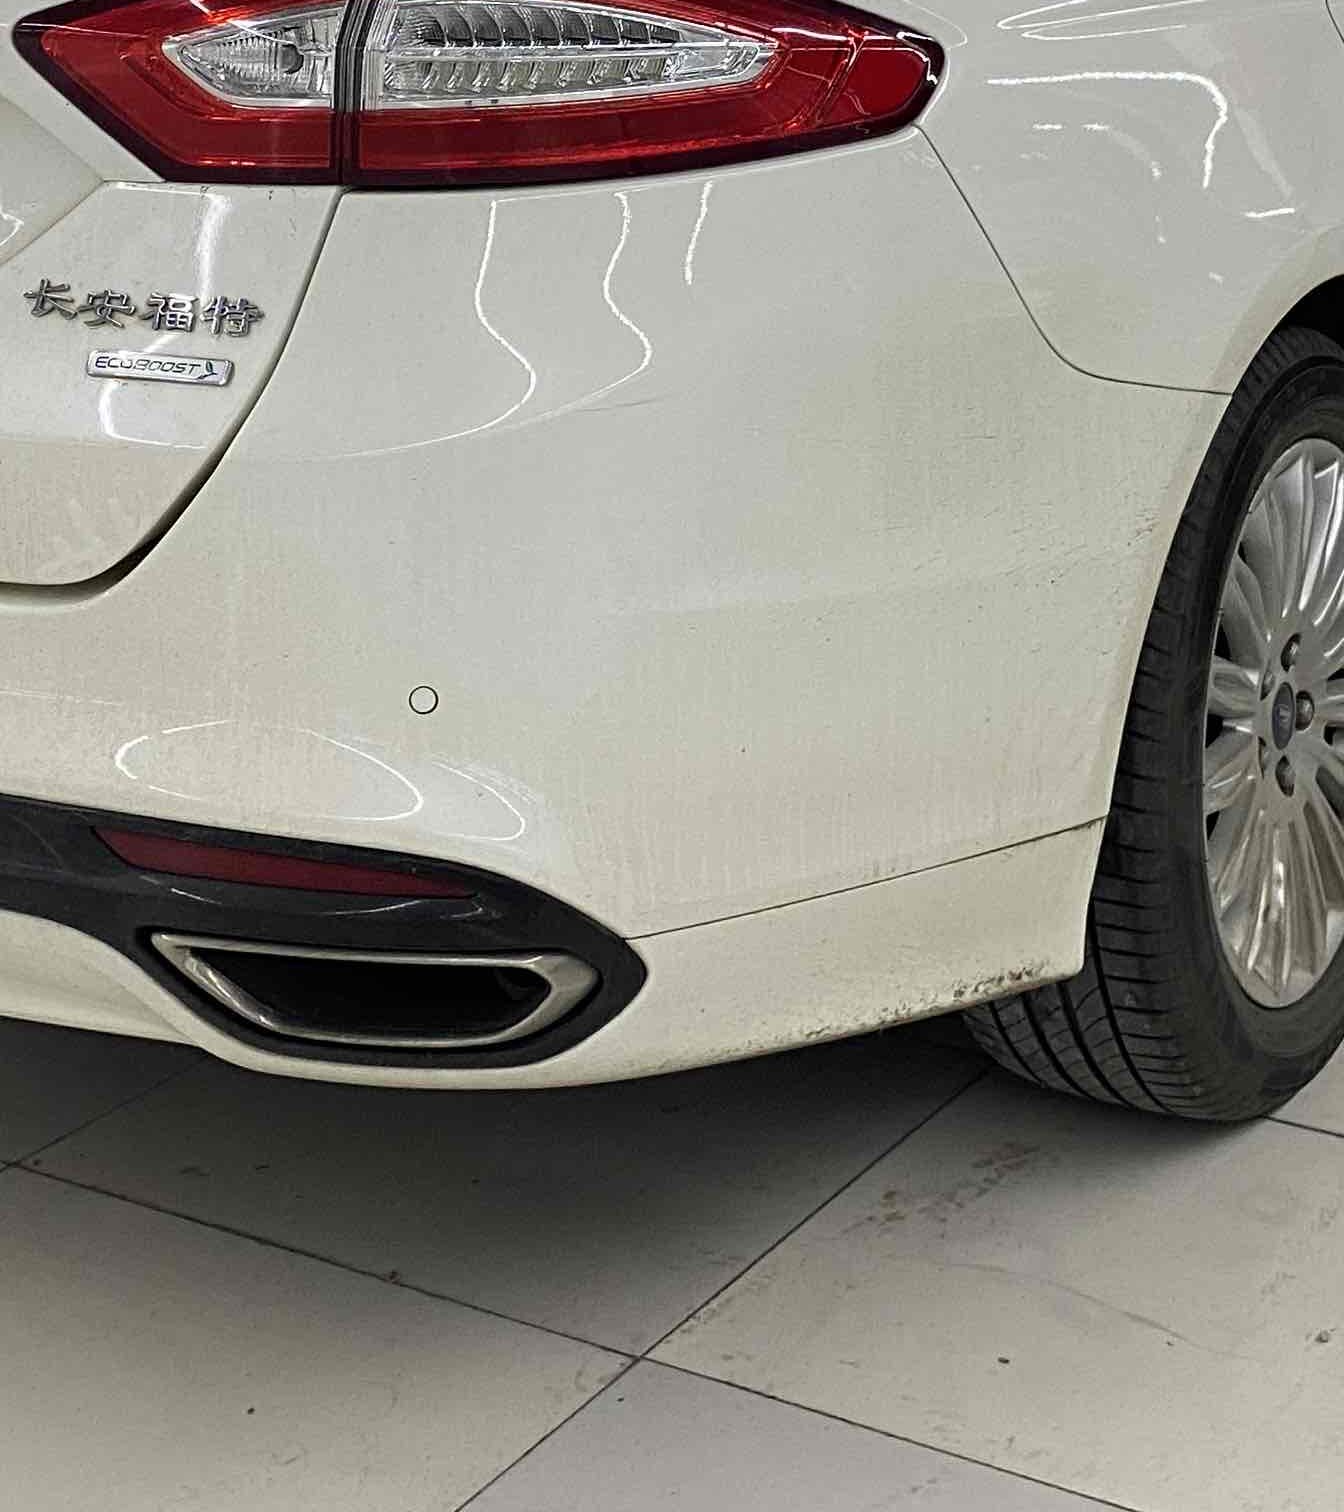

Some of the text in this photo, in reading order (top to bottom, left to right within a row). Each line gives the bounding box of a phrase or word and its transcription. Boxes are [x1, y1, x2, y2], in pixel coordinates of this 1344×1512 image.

[23, 278, 266, 338] 长安福特
[96, 355, 202, 376] ECOBOOST
